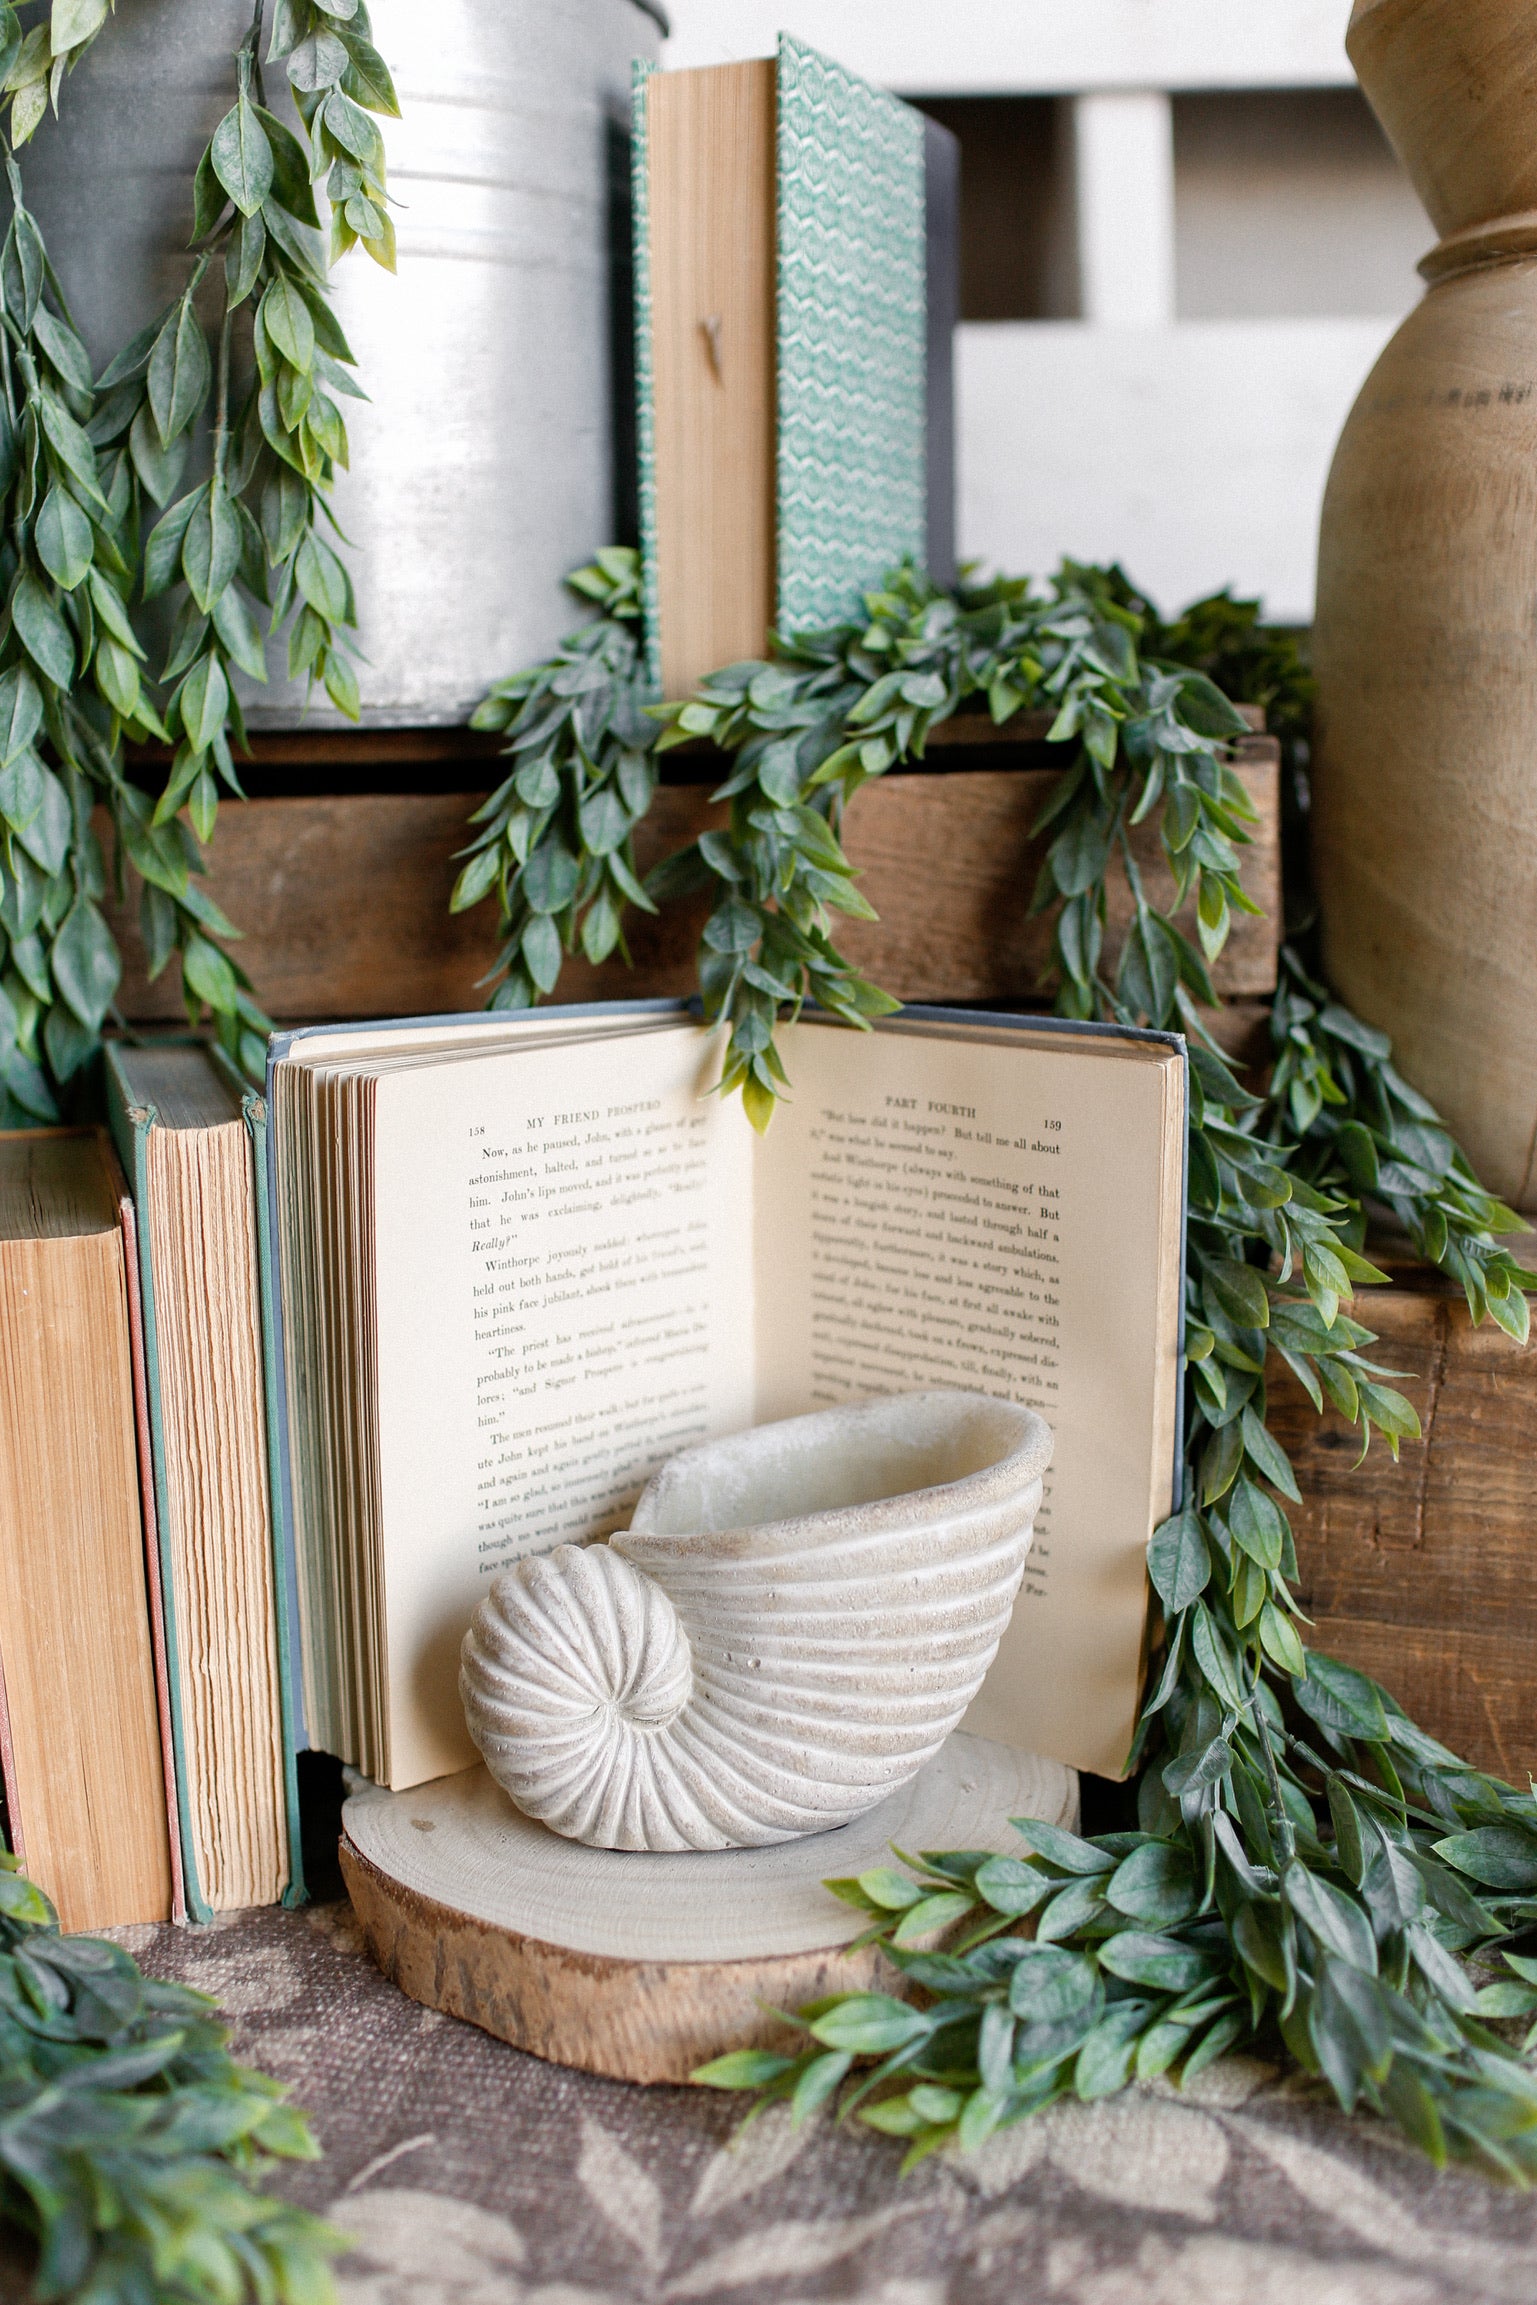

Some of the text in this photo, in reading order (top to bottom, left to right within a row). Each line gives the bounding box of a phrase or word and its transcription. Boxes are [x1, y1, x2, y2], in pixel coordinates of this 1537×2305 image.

[885, 1096, 977, 1119] PART FOURTH
[526, 1117, 545, 1130] MY
[553, 1110, 601, 1126] FRIEND
[1044, 1119, 1062, 1132] 159
[468, 1126, 485, 1137] 158
[953, 1126, 973, 1140] But
[975, 1131, 992, 1144] tell
[995, 1137, 1010, 1147] me
[1013, 1137, 1026, 1150] all
[1030, 1139, 1060, 1155] about
[482, 1147, 508, 1159] Now,
[511, 1146, 522, 1154] as
[526, 1141, 538, 1153] he
[542, 1134, 581, 1154] paused,
[584, 1131, 611, 1144] John,
[468, 1166, 537, 1186] astonishment,
[544, 1158, 578, 1174] halted,
[584, 1154, 603, 1167] and
[469, 1195, 491, 1208] him.
[500, 1187, 534, 1203] John’s
[537, 1185, 556, 1199] lips
[558, 1178, 592, 1194] moved,
[594, 1173, 612, 1187] and
[945, 1169, 967, 1182] with
[969, 1176, 1019, 1195] something
[1021, 1183, 1034, 1194] of
[1037, 1184, 1060, 1199] that
[981, 1196, 993, 1208] to
[994, 1201, 1031, 1215] answer.
[1039, 1206, 1059, 1220] But
[469, 1217, 490, 1230] that
[499, 1213, 512, 1225] he
[520, 1212, 539, 1221] was
[982, 1217, 1023, 1236] through
[1027, 1225, 1048, 1240] half
[1052, 1233, 1059, 1242] a
[471, 1233, 517, 1252] Really?”
[484, 1255, 539, 1272] Winthorpe
[997, 1243, 1059, 1264] ambulations.
[472, 1282, 494, 1297] held
[498, 1279, 515, 1292] out
[519, 1274, 541, 1288] both
[545, 1267, 576, 1283] hands,
[981, 1261, 1008, 1277] story
[1012, 1266, 1045, 1283] which,
[1048, 1276, 1060, 1285] as
[977, 1282, 1025, 1298] agreeable
[1028, 1290, 1040, 1301] to
[1043, 1292, 1059, 1306] the
[473, 1306, 488, 1319] his
[492, 1301, 515, 1319] pink
[518, 1298, 539, 1310] face
[985, 1302, 999, 1315] all
[1002, 1308, 1034, 1321] awake
[1037, 1313, 1059, 1327] with
[474, 1323, 526, 1341] heartiness.
[966, 1322, 1016, 1341] gradually
[1018, 1331, 1060, 1349] sobered,
[488, 1345, 515, 1358] “The
[521, 1338, 549, 1356] priest
[476, 1365, 520, 1388] probably
[523, 1363, 534, 1373] to
[536, 1359, 547, 1371] be
[1020, 1373, 1042, 1386] with
[1045, 1380, 1059, 1390] an
[476, 1392, 505, 1406] lores;
[512, 1381, 537, 1396] “and
[477, 1410, 505, 1427] him.”
[489, 1432, 509, 1445] The
[512, 1428, 532, 1440] men
[477, 1458, 493, 1470] ute
[497, 1450, 522, 1464] John
[477, 1475, 496, 1490] and
[499, 1469, 527, 1486] again
[530, 1462, 549, 1477] and
[477, 1498, 489, 1510] “I
[491, 1497, 507, 1508] am
[509, 1493, 520, 1503] so
[477, 1520, 496, 1531] was
[497, 1512, 523, 1529] quite
[477, 1533, 513, 1553] though
[478, 1561, 499, 1574] face
